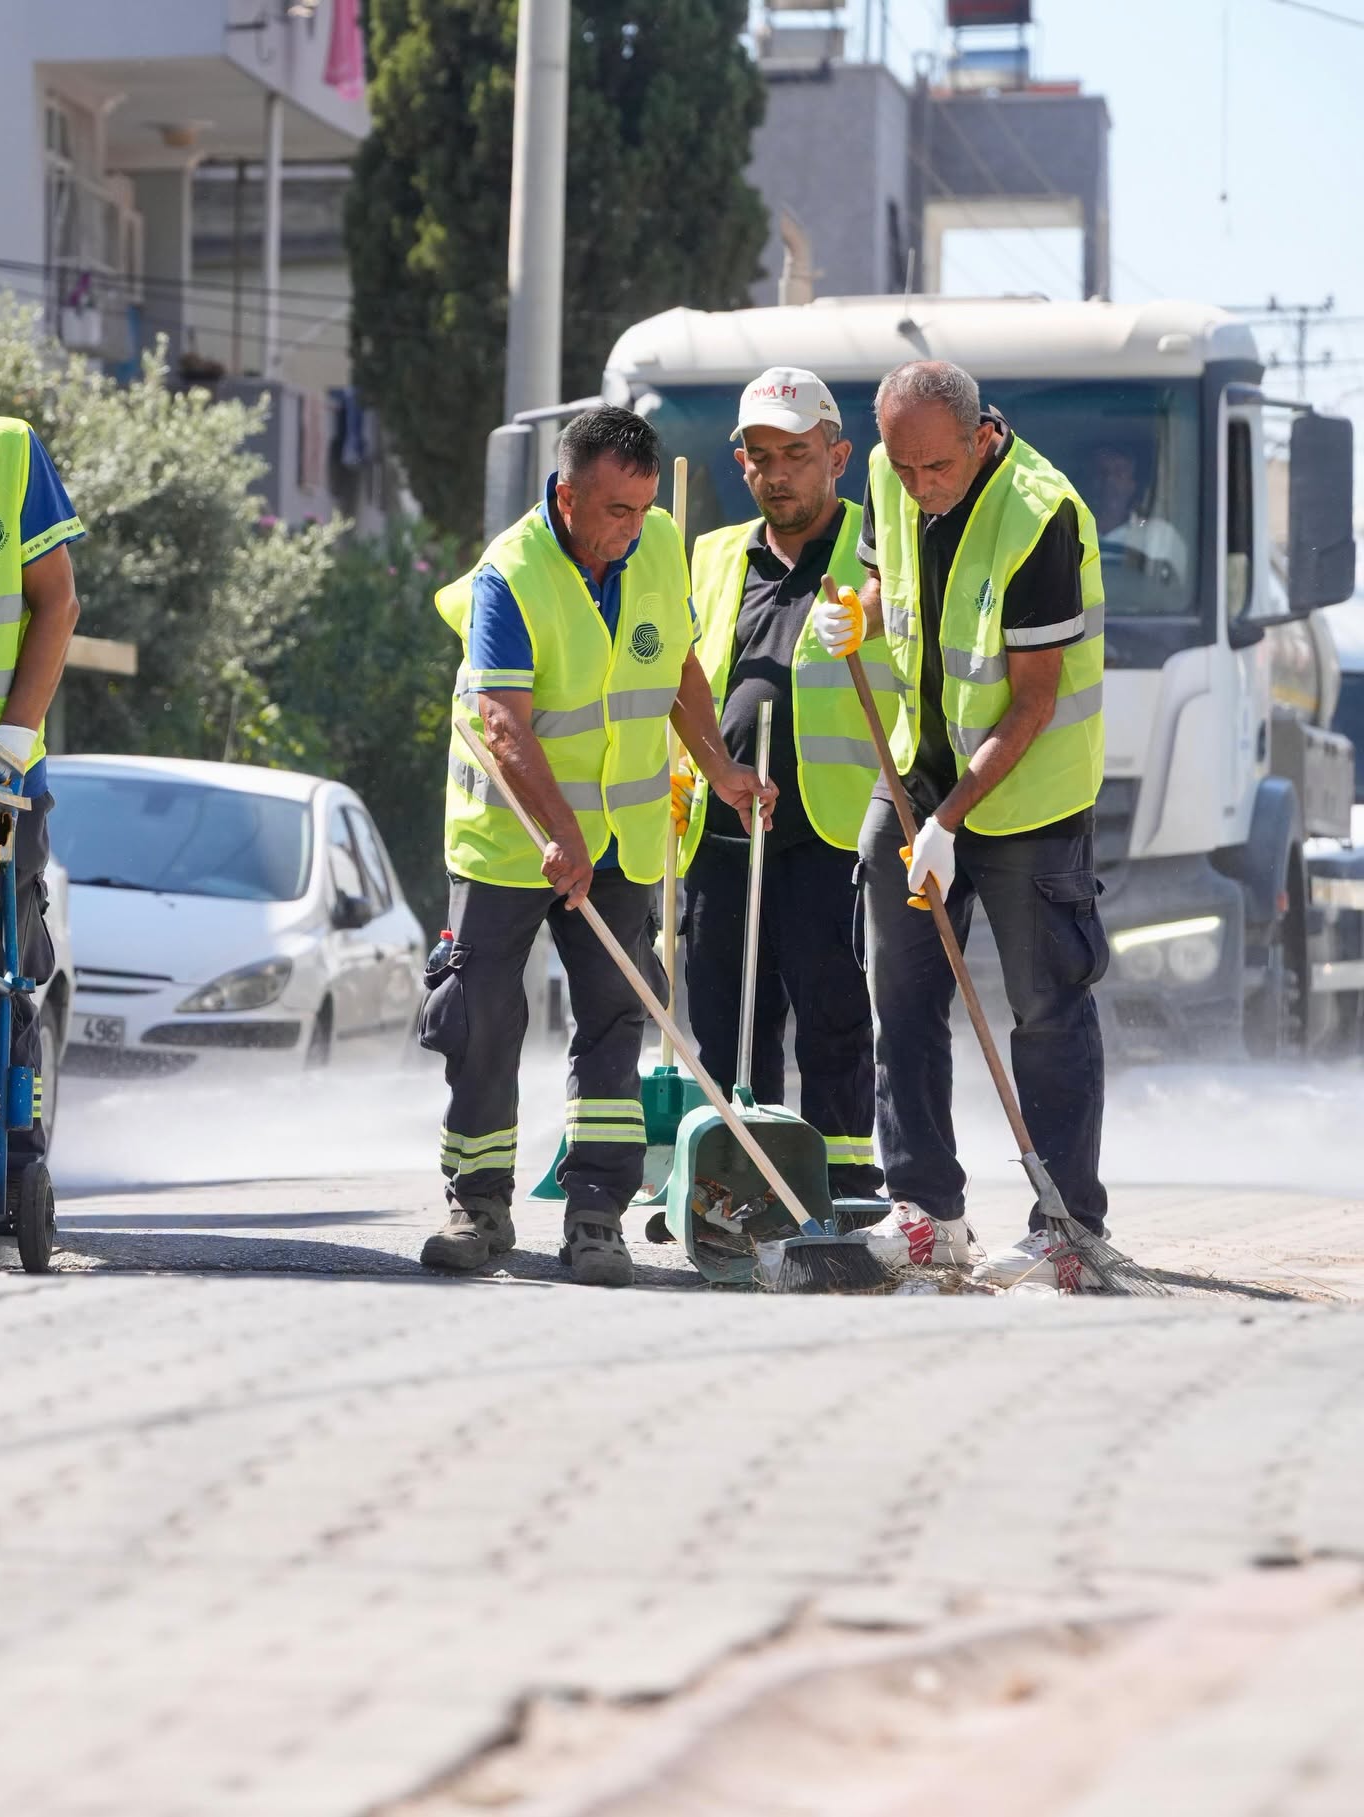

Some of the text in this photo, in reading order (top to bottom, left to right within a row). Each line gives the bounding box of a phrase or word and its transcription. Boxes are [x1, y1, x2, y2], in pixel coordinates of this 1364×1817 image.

[750, 385, 797, 401] DIVA F1
[627, 645, 644, 665] SEYHAN
